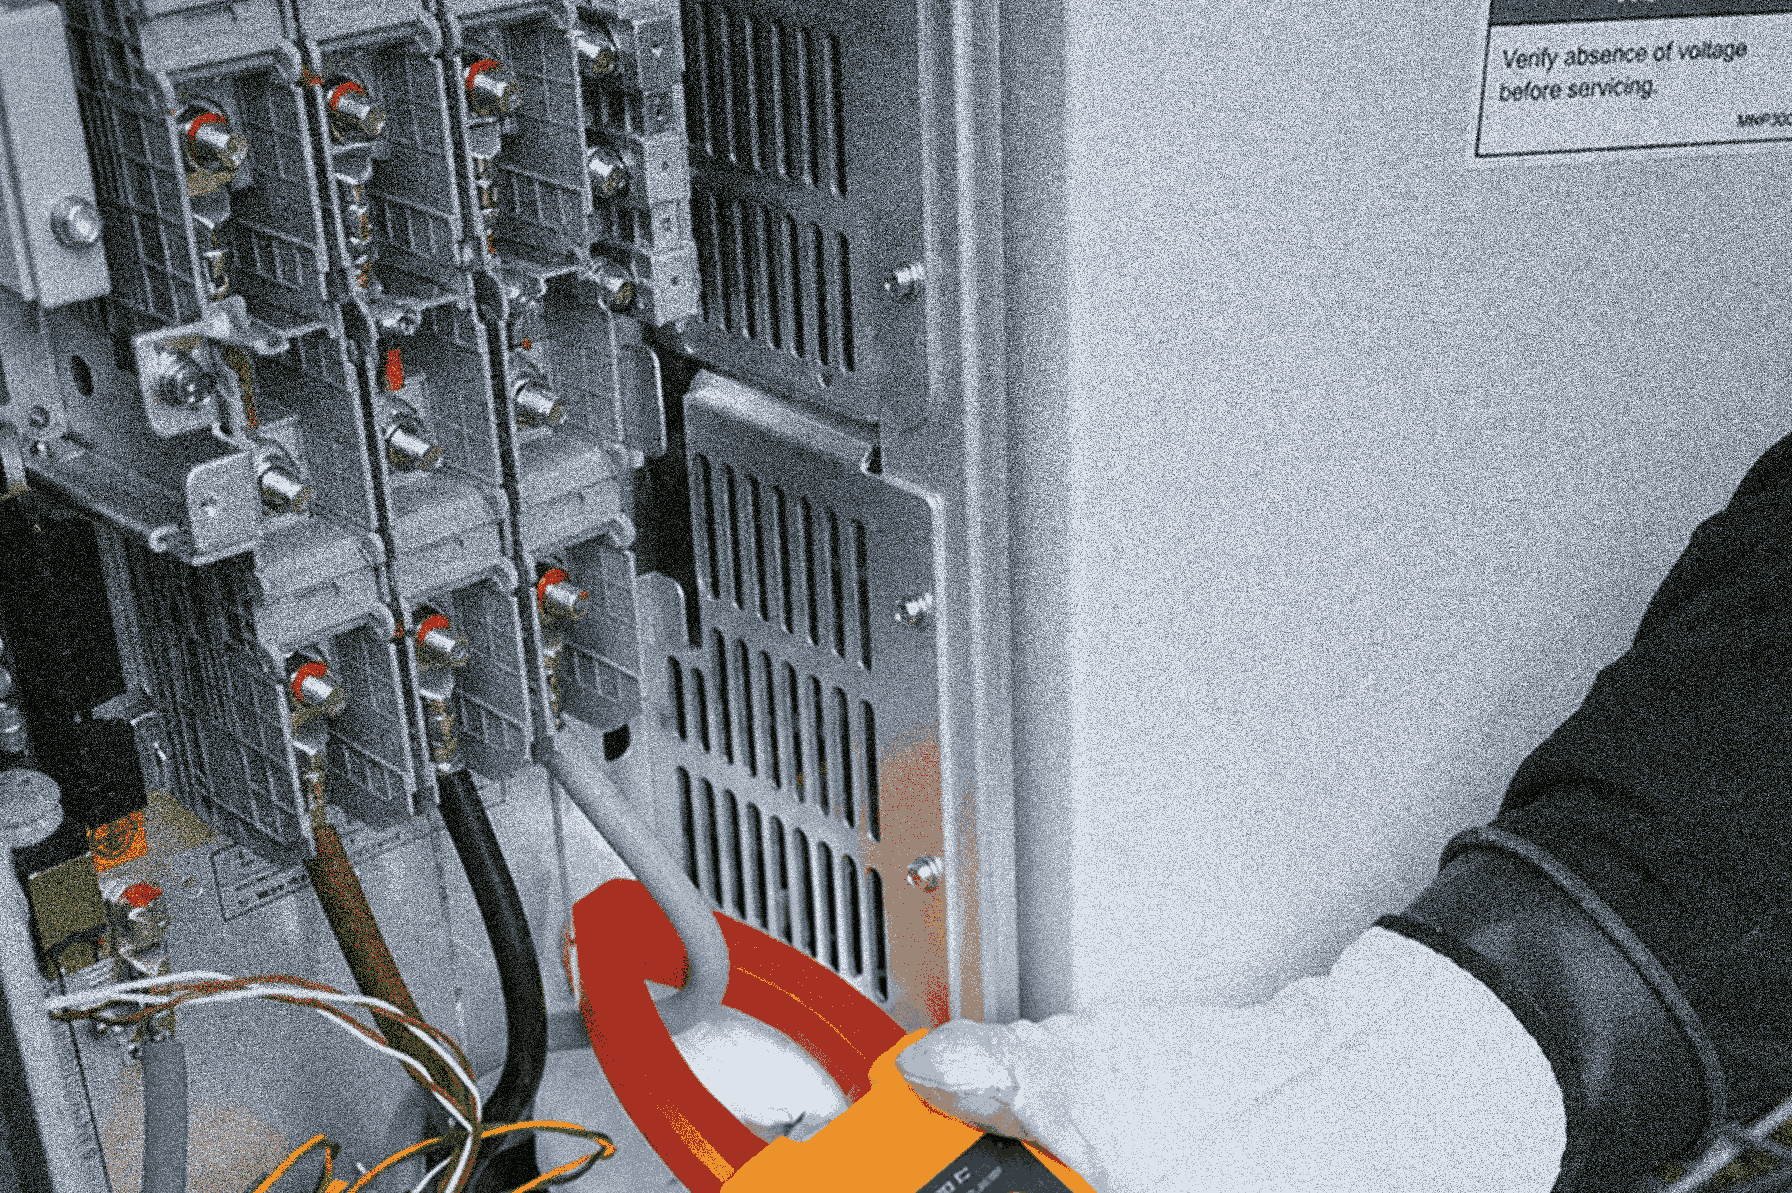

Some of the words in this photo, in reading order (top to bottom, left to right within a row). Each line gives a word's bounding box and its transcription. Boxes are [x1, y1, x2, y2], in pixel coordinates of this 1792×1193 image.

[1503, 46, 1558, 74] Verify
[1564, 44, 1647, 67] absence
[1653, 41, 1674, 61] of
[1679, 40, 1748, 63] voltage
[1499, 80, 1562, 101] before
[1567, 77, 1659, 100] servicing.
